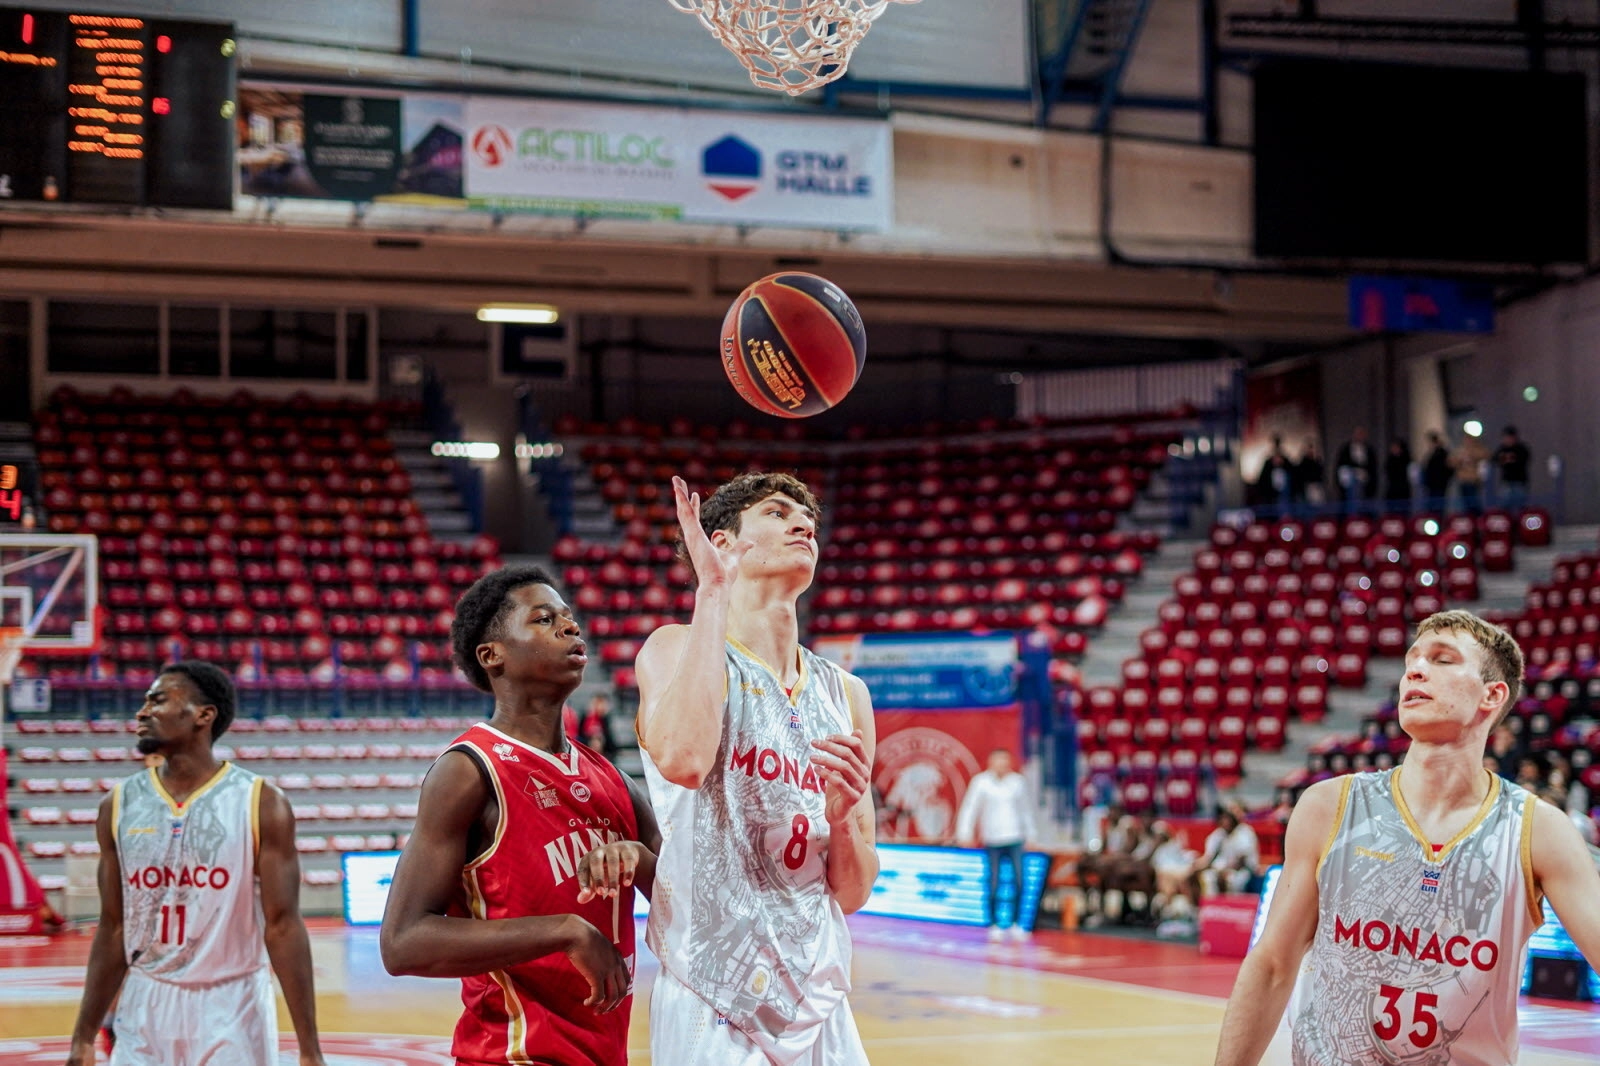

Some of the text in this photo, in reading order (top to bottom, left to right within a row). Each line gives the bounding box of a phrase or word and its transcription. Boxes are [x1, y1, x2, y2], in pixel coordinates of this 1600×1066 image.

[517, 127, 675, 168] ACTILOC
[776, 150, 848, 171] GTM
[776, 174, 872, 197] HALLE
[747, 338, 802, 410] LEGACY
[729, 745, 835, 794] MONA
[783, 813, 810, 871] 8
[128, 865, 229, 890] MONACO
[161, 905, 186, 945] 11
[1333, 914, 1499, 972] MONACO
[1373, 984, 1438, 1049] 35
